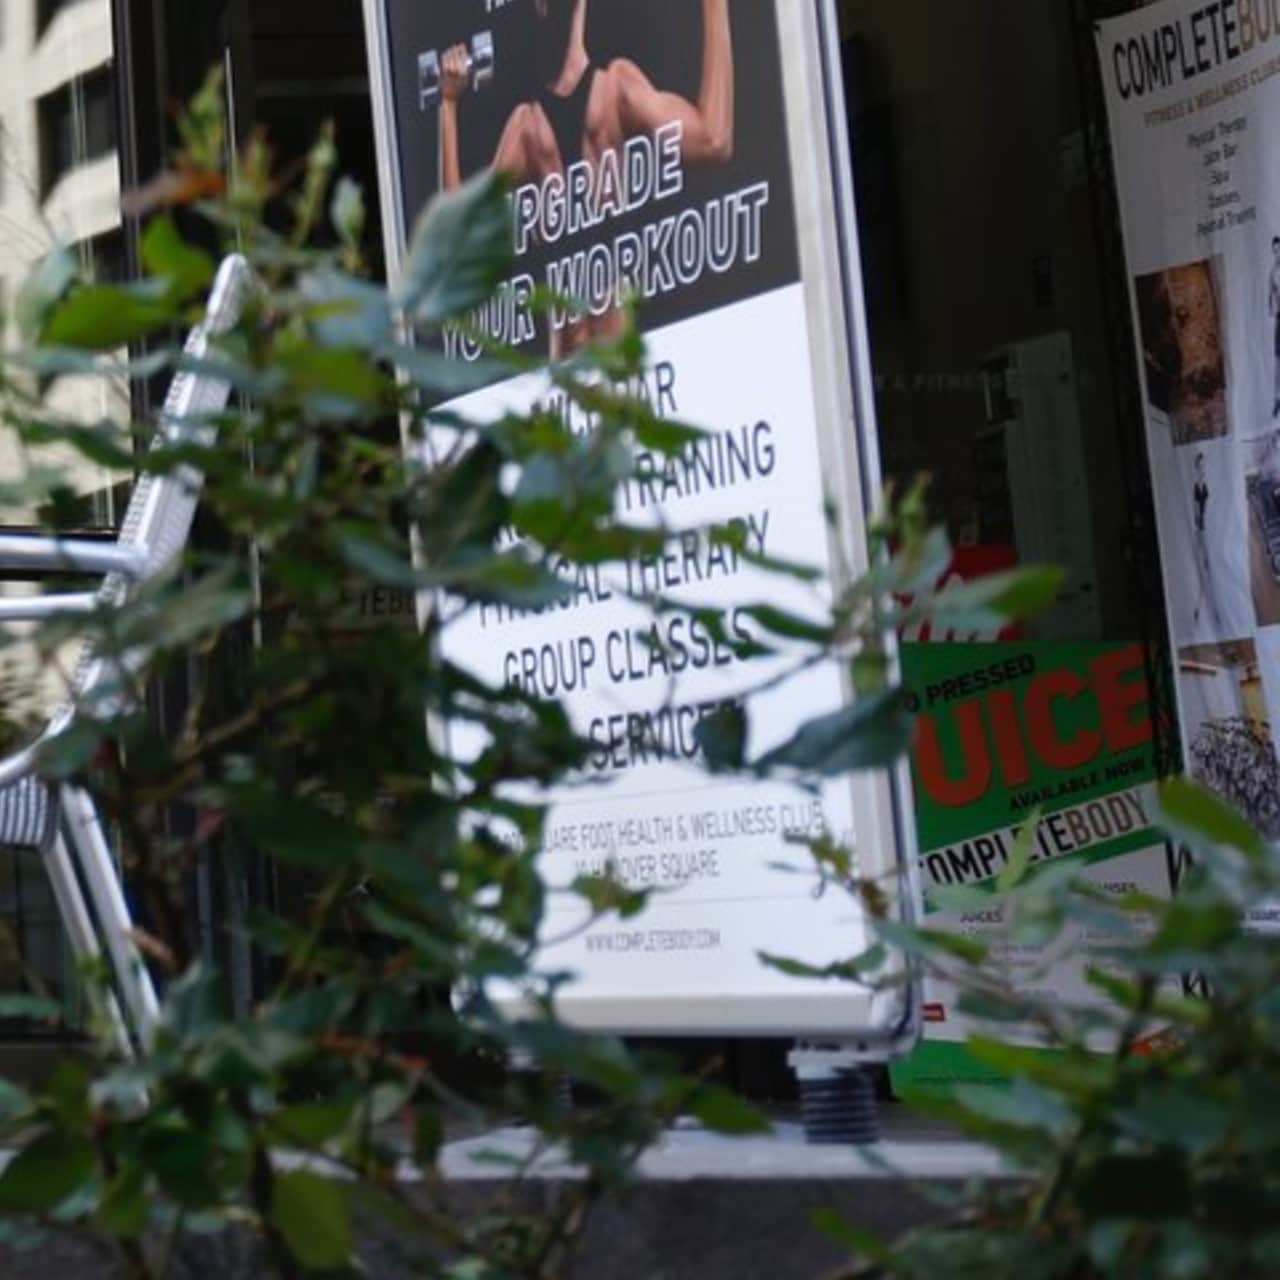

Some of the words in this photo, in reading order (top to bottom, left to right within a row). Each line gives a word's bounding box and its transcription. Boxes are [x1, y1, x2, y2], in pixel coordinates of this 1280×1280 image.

[508, 120, 684, 256] PGRADE
[545, 181, 770, 330] WORKOUT
[624, 510, 769, 598] THERAY
[504, 637, 595, 696] GROUP
[924, 653, 1036, 707] PRESSED
[589, 698, 738, 770] SERVIC
[914, 646, 1152, 810] UICE
[617, 816, 674, 847] HEALTH
[691, 805, 776, 840] WELLNESS
[660, 849, 720, 880] SQUARE
[919, 786, 1149, 886] OMPLTEBODY
